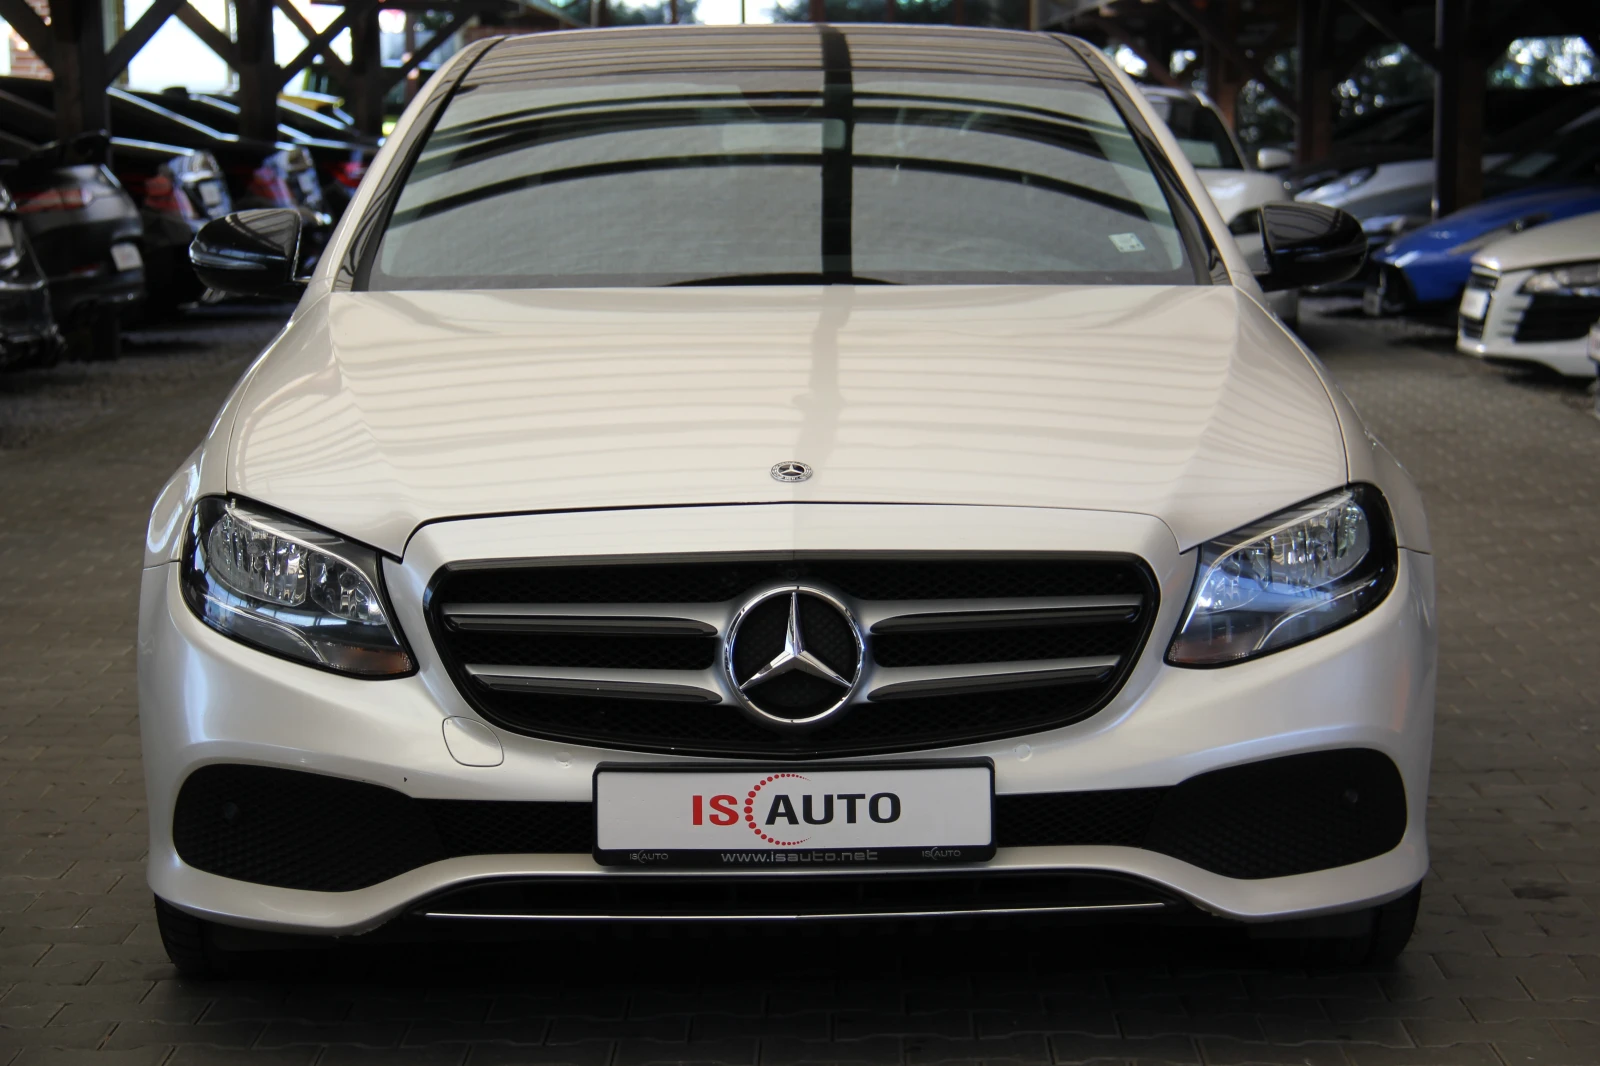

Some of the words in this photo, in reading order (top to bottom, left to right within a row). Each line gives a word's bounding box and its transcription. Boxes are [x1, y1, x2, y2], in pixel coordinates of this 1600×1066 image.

[692, 794, 739, 826] IS
[765, 792, 902, 825] AUTO
[721, 849, 878, 862] www.isauto.net
